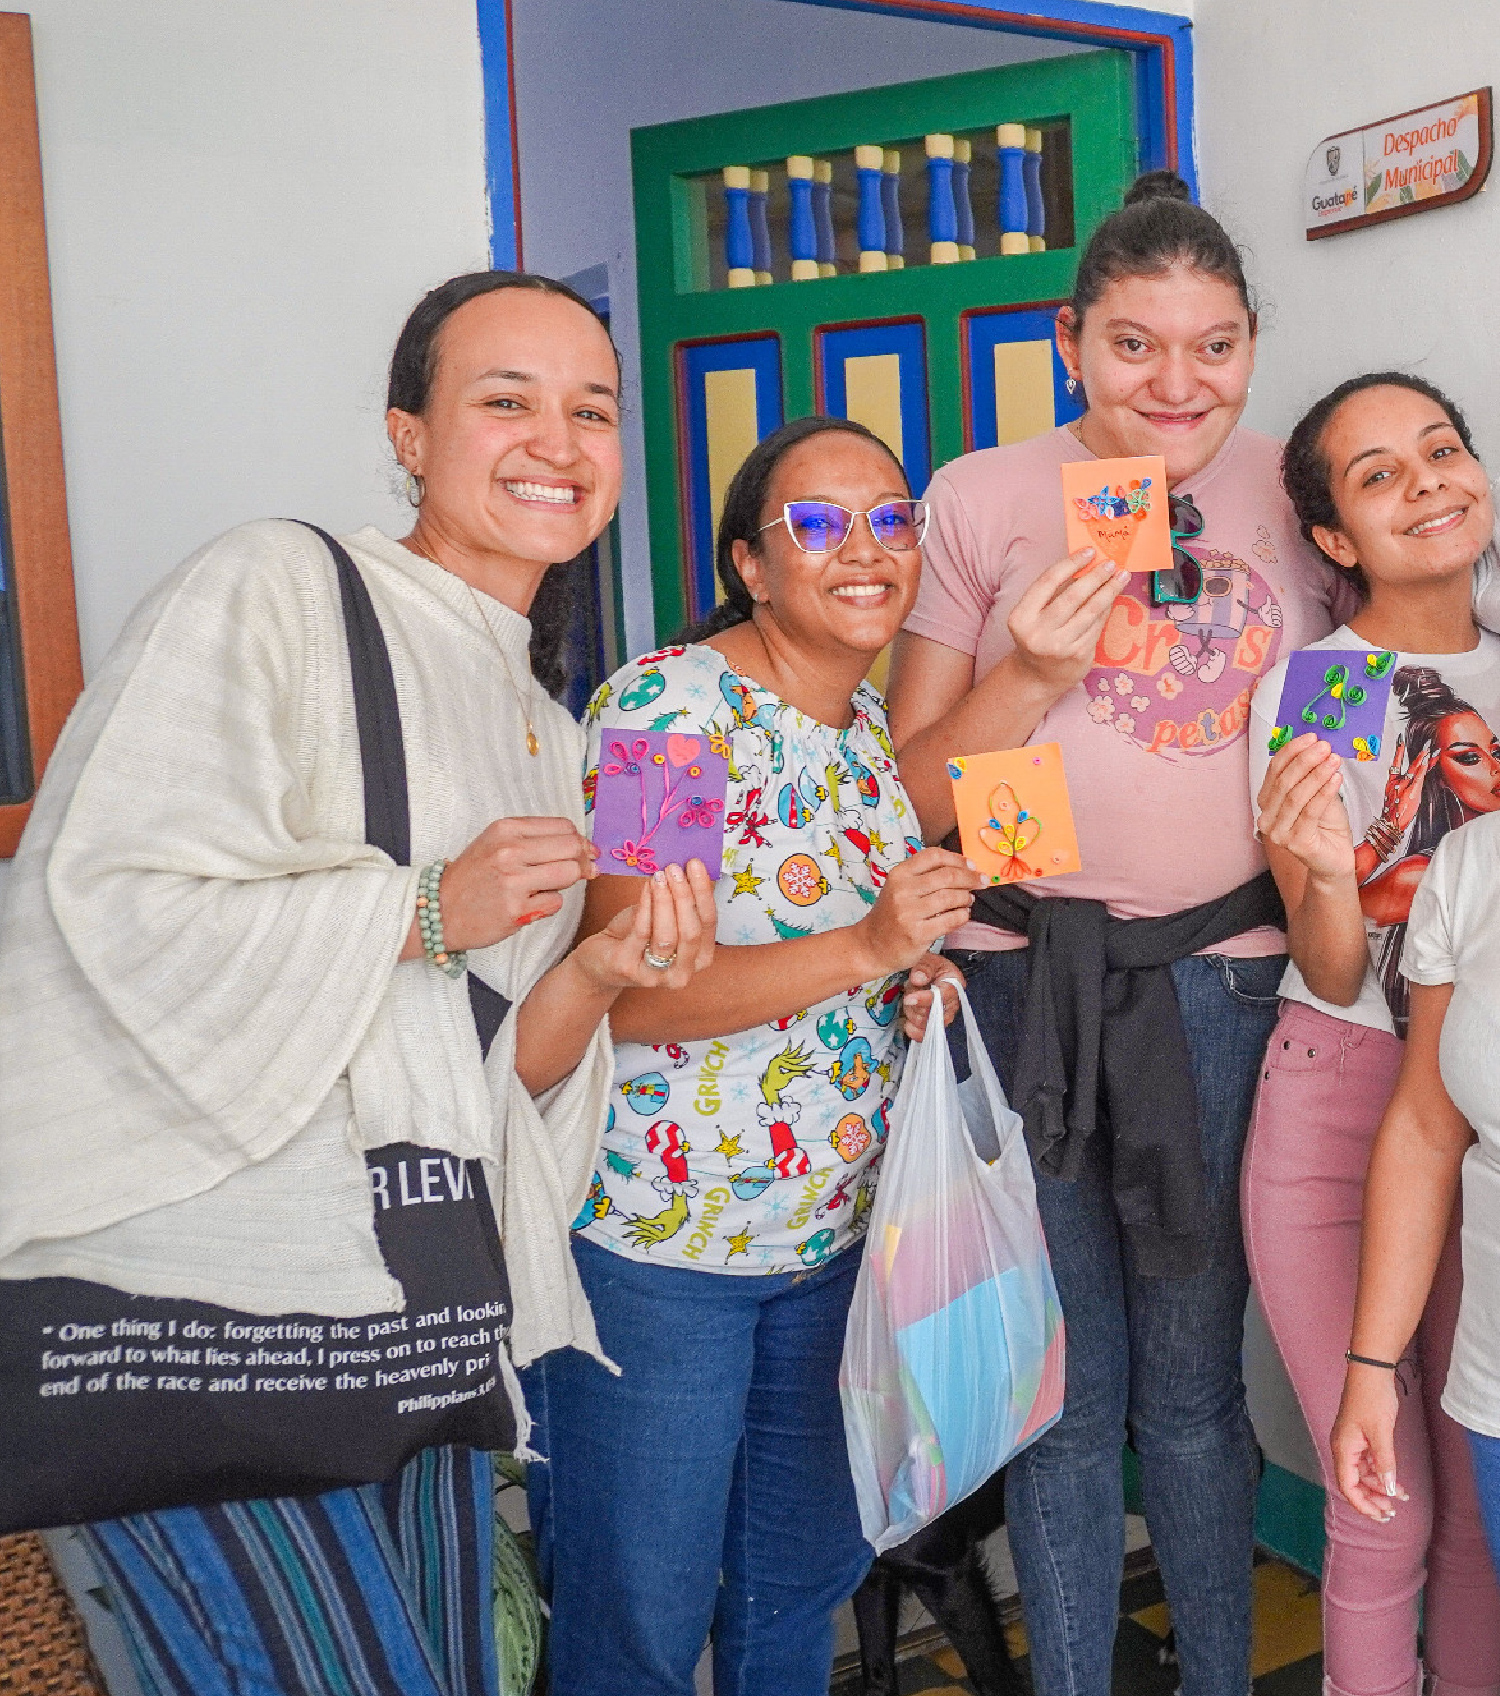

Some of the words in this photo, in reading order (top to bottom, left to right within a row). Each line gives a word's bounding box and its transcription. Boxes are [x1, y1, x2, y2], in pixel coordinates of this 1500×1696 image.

[1384, 117, 1457, 156] Despacho
[1384, 149, 1459, 191] Municipal
[1312, 185, 1358, 210] Guatapé
[693, 1041, 730, 1116] GRINCH
[786, 1166, 834, 1230] GRINCH
[682, 1187, 731, 1260] GRINCH
[58, 1322, 107, 1342] One
[111, 1318, 163, 1341] thing
[168, 1320, 177, 1337] I
[223, 1320, 324, 1344] forgetting
[330, 1322, 361, 1340] the
[368, 1316, 409, 1341] past
[415, 1307, 450, 1328] and
[42, 1345, 123, 1370] forward
[125, 1347, 147, 1364] to
[151, 1344, 201, 1365] what
[205, 1348, 242, 1366] lies
[245, 1348, 312, 1367] ahead,
[317, 1348, 325, 1365] I
[329, 1348, 383, 1369] press
[386, 1343, 412, 1360] on
[416, 1338, 436, 1354] to
[441, 1328, 491, 1350] reach
[39, 1375, 81, 1397] end
[86, 1371, 112, 1392] of
[116, 1371, 153, 1391] the
[157, 1375, 203, 1392] race
[208, 1373, 250, 1392] and
[255, 1374, 329, 1392] receive
[335, 1372, 369, 1390] the
[375, 1357, 460, 1387] heavenly
[397, 1389, 477, 1414] Philippians
